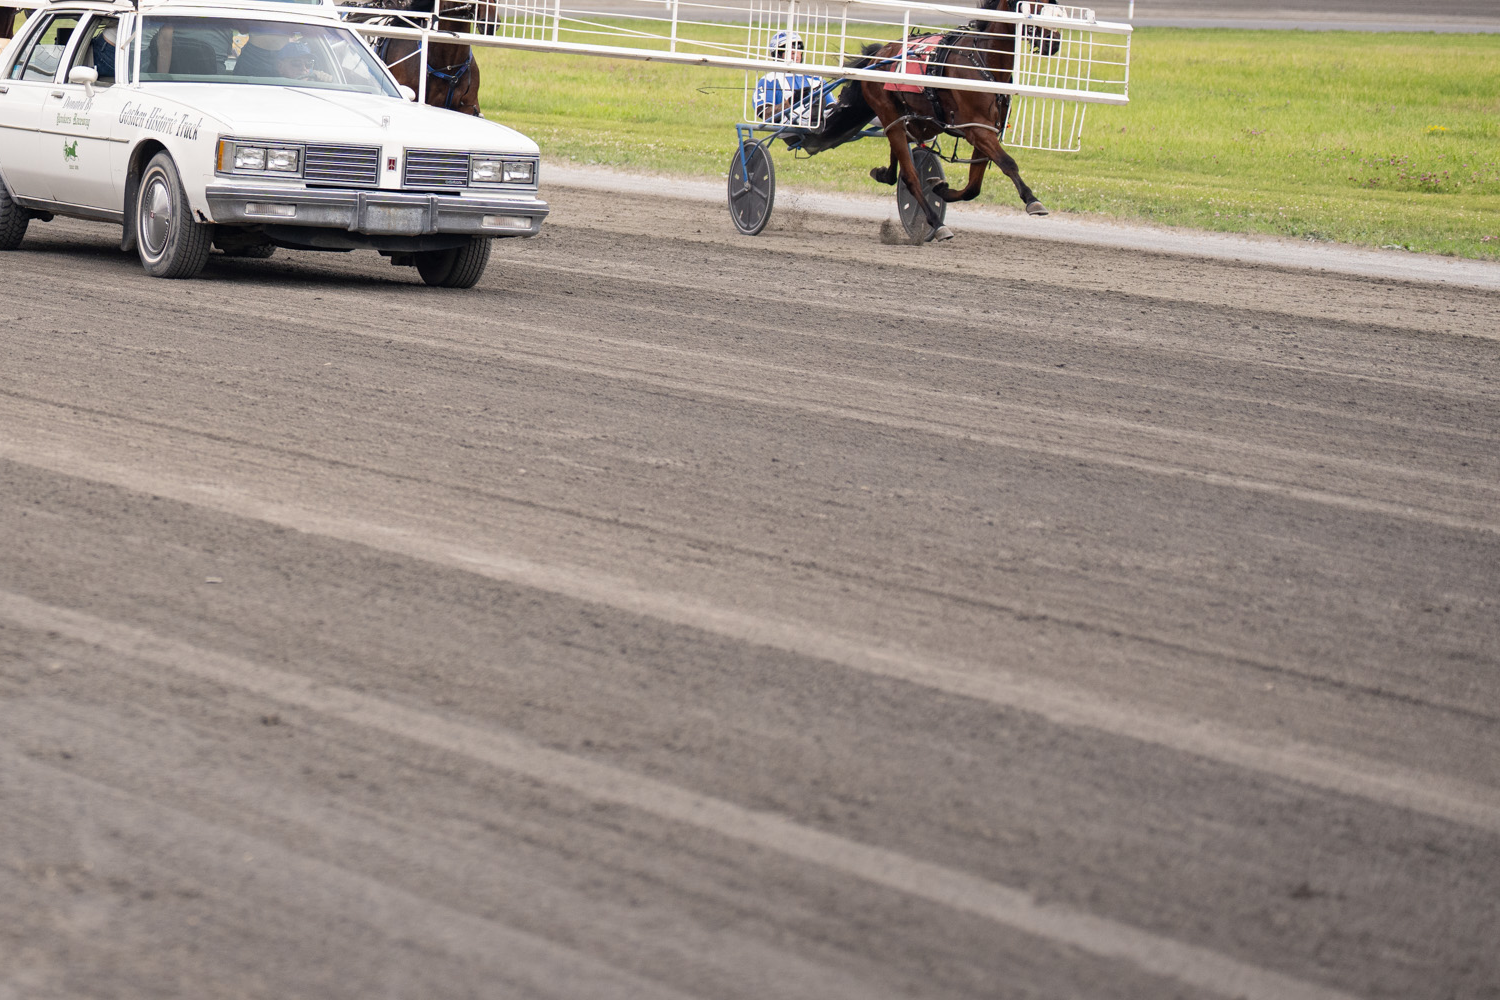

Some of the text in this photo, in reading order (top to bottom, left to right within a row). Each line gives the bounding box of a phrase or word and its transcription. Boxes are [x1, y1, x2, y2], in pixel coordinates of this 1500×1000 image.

[62, 96, 87, 110] Donated
[118, 101, 203, 141] Goshen Historic Track
